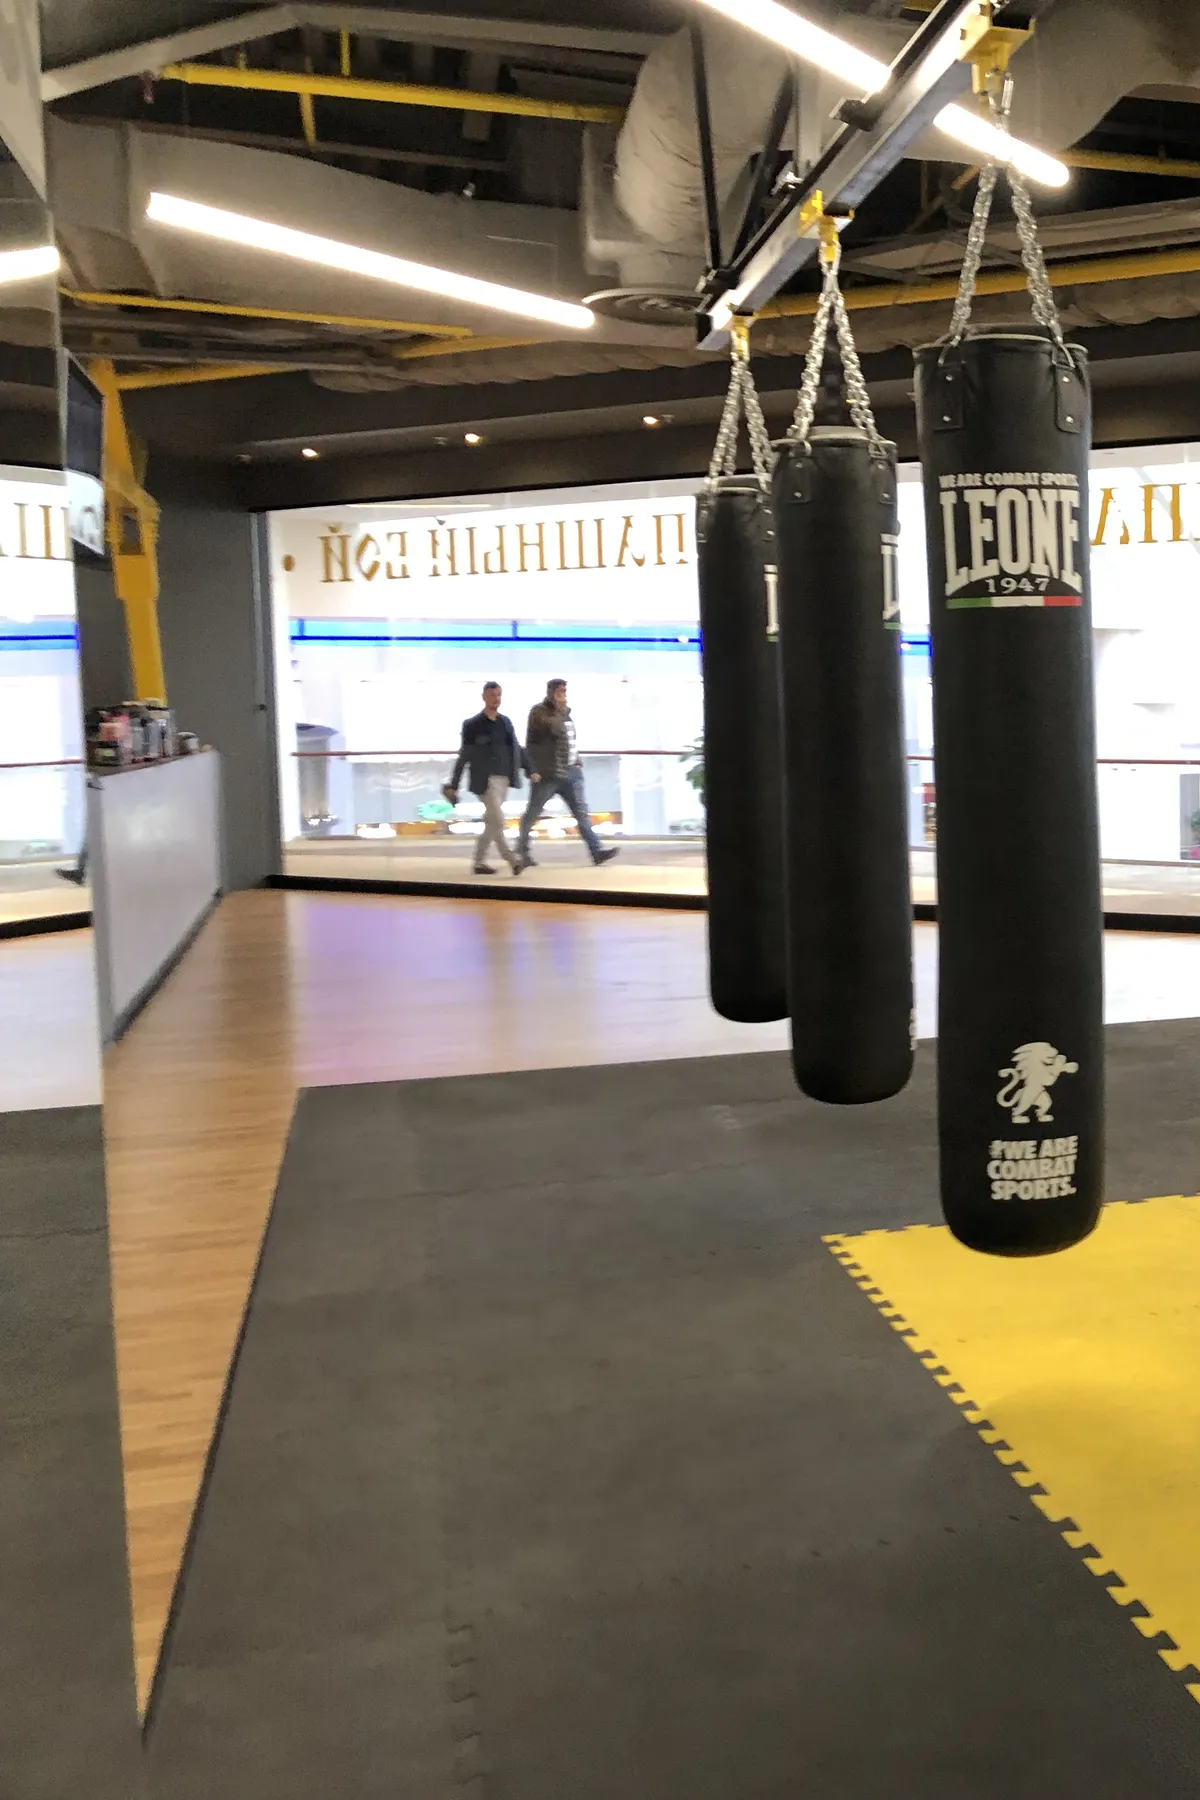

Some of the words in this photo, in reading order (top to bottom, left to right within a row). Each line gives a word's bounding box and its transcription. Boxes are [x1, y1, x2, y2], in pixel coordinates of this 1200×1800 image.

[939, 474, 957, 489] WE
[957, 473, 983, 487] ARE
[984, 472, 1040, 486] COMBAT
[939, 488, 1083, 596] LEONE
[986, 577, 1050, 594] 1947
[1038, 1135, 1078, 1158] ARE
[986, 1154, 1078, 1180] COMBAT
